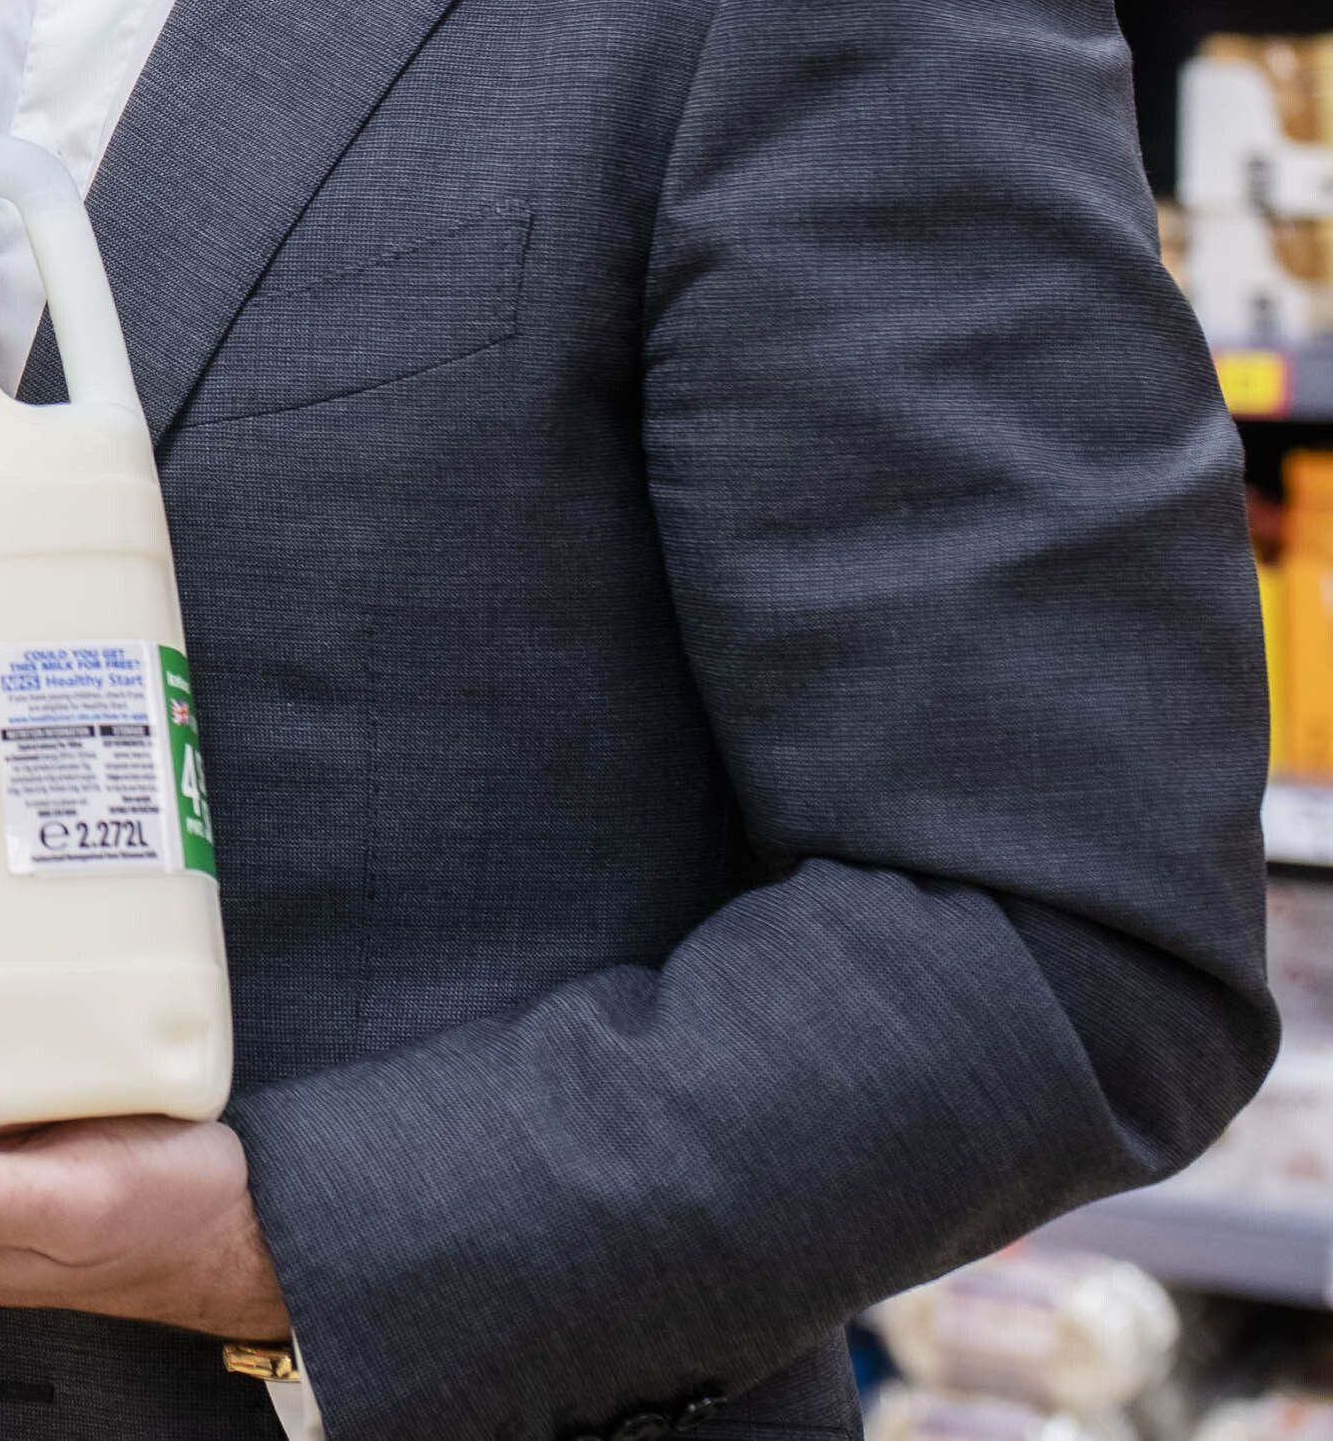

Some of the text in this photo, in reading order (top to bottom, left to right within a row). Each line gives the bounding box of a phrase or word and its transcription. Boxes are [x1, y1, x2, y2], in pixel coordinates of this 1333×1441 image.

[23, 647, 125, 661] COULD YOU GET
[10, 659, 141, 672] THIS MILK FOR FREE?
[46, 674, 103, 689] Healthy
[108, 673, 144, 686] Start
[76, 820, 149, 849] 2.272L
